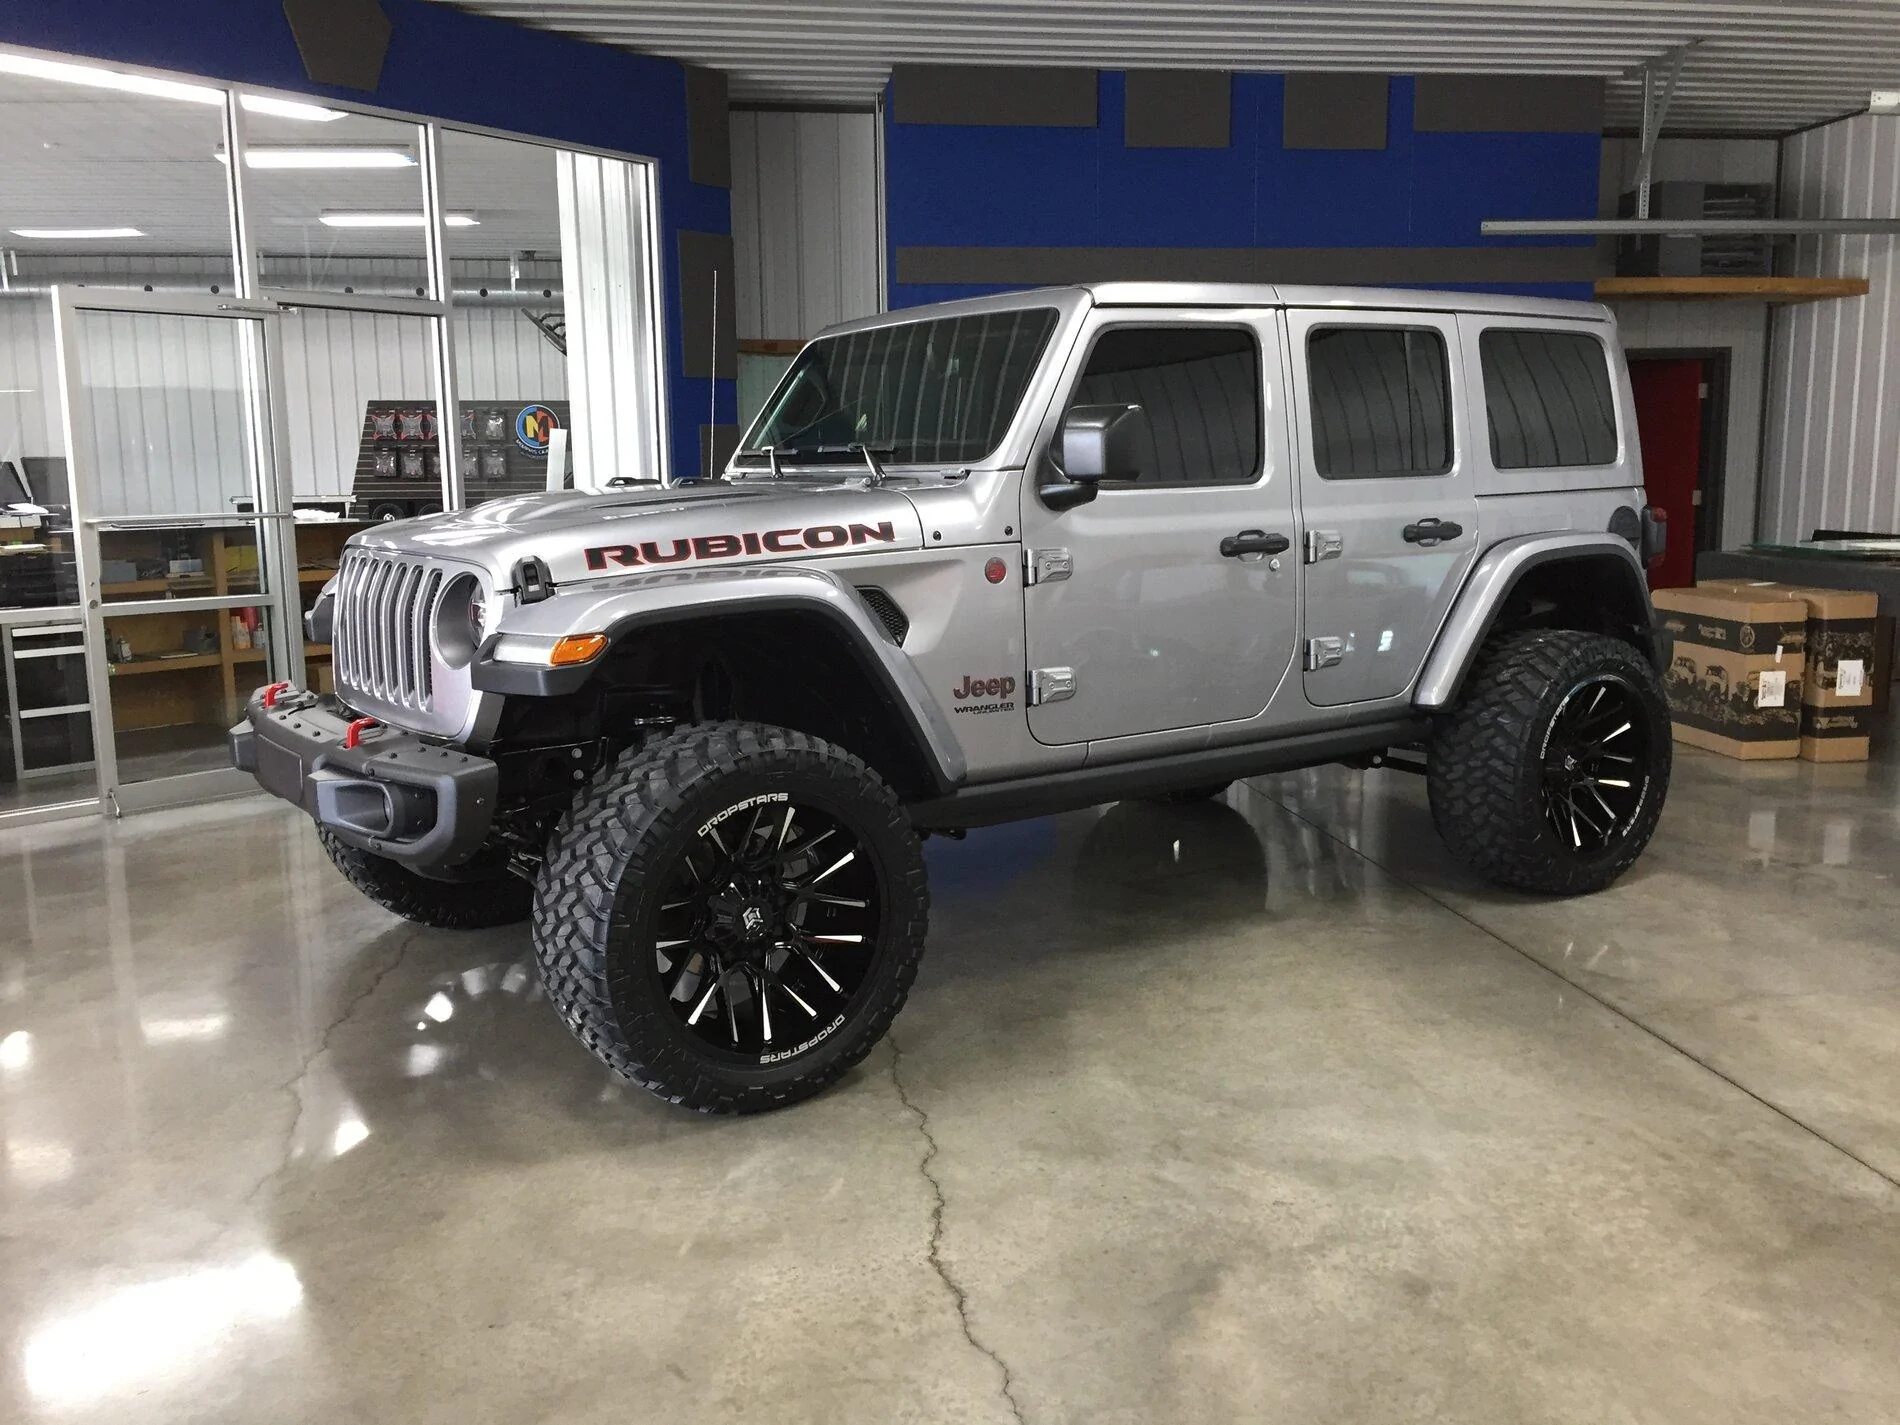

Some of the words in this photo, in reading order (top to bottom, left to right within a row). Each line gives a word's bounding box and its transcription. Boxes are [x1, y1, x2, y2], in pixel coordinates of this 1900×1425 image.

[584, 521, 895, 571] RUBICON
[953, 675, 1015, 699] Jeep
[954, 702, 1014, 714] WRANGLER
[697, 792, 788, 837] DROPSTARS
[759, 1014, 846, 1064] DROPSTARS
